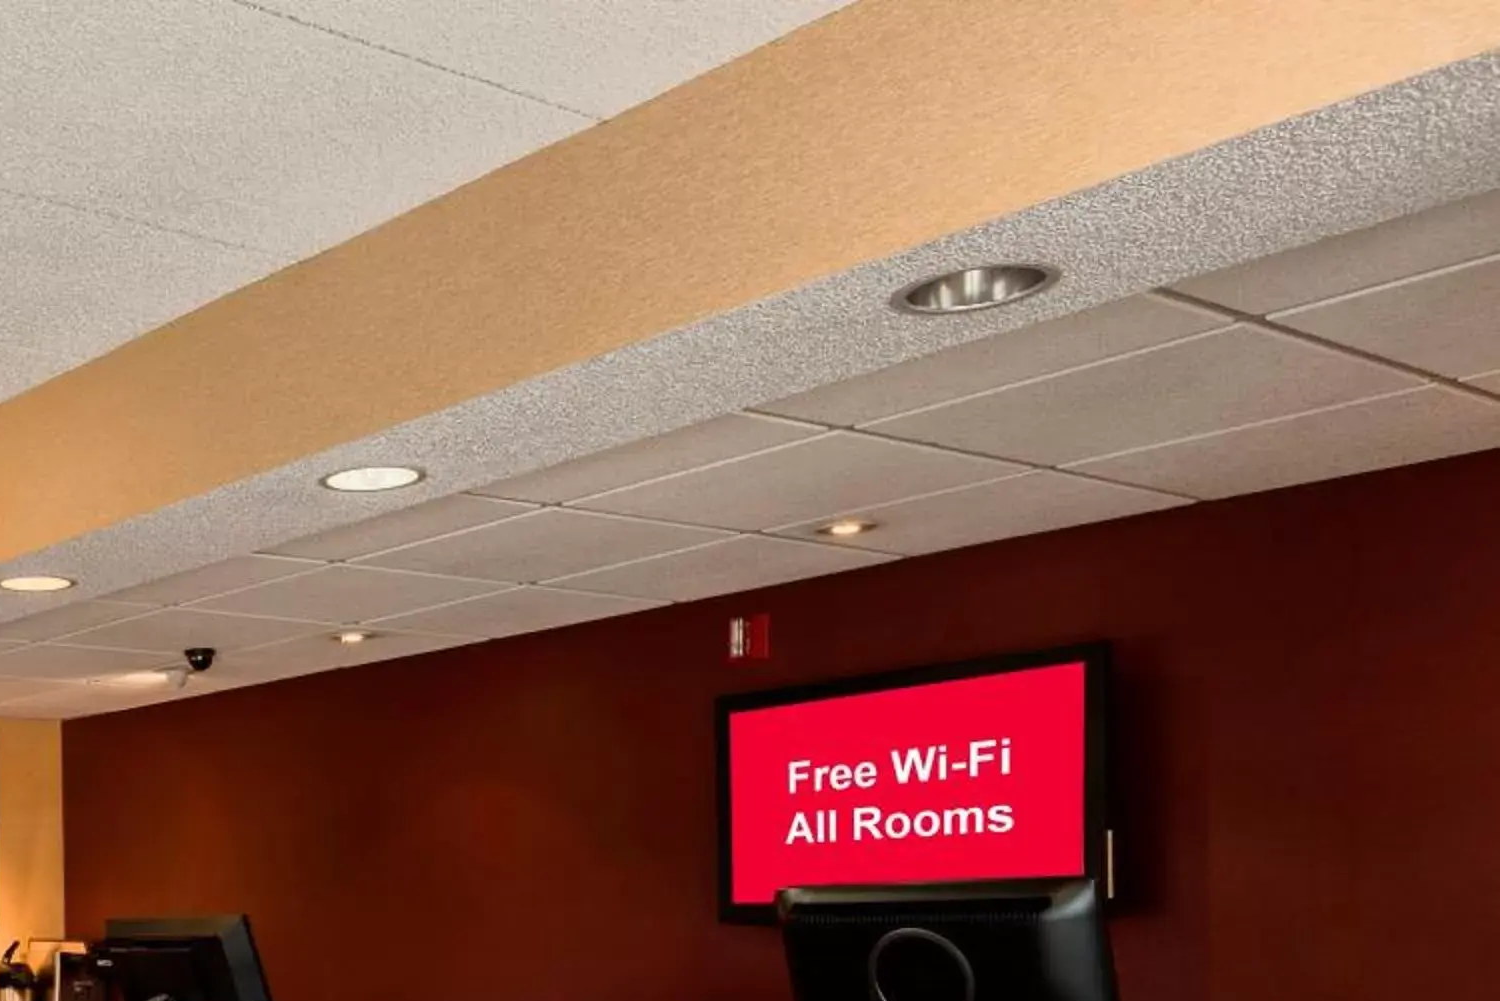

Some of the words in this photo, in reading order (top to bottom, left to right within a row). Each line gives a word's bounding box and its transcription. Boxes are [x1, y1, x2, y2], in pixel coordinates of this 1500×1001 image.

[787, 758, 878, 794] Free
[890, 737, 1012, 784] Wi-Fi
[785, 806, 837, 845] All
[852, 804, 1015, 843] Rooms
